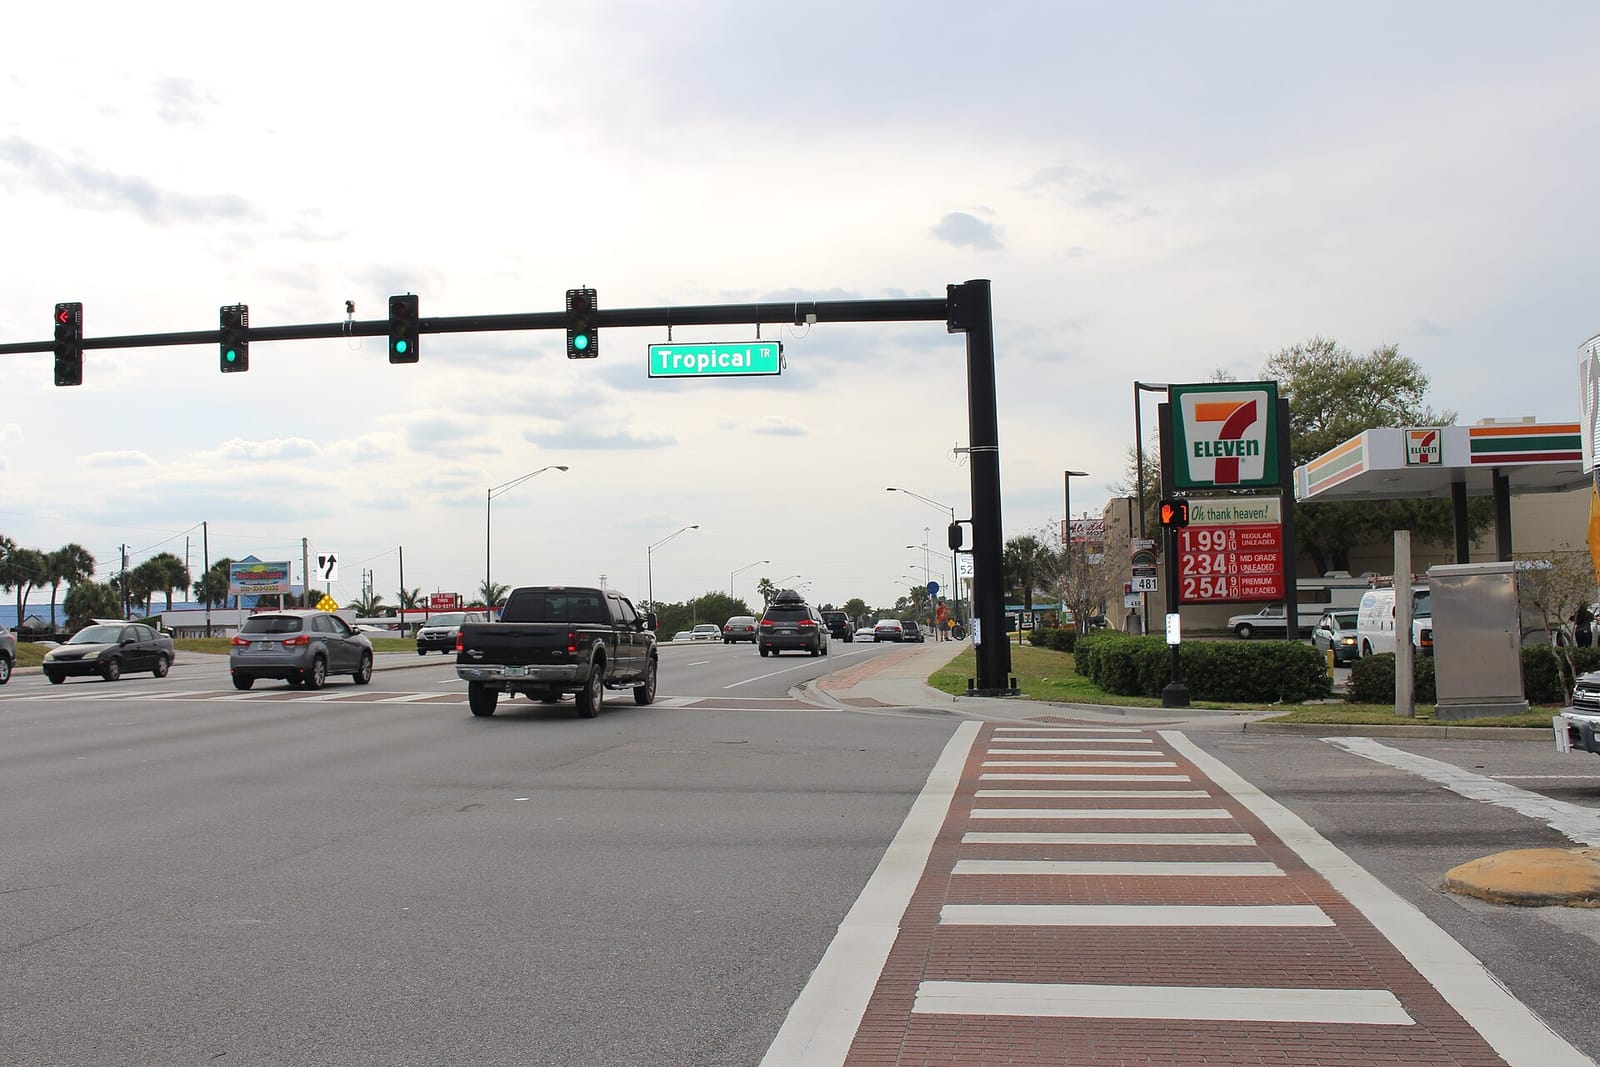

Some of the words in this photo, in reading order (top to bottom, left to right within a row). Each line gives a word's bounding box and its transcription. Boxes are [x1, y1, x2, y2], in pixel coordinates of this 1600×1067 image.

[657, 348, 751, 373] Tropical
[759, 348, 771, 358] TR
[1195, 399, 1257, 484] 7
[1411, 431, 1436, 463] 7
[1191, 505, 1204, 521] Oh
[1207, 507, 1232, 520] thank
[1234, 504, 1269, 519] heaven!
[1182, 530, 1226, 552] 1.99
[1182, 553, 1227, 575] 2.34
[1183, 577, 1228, 599] 2.54
